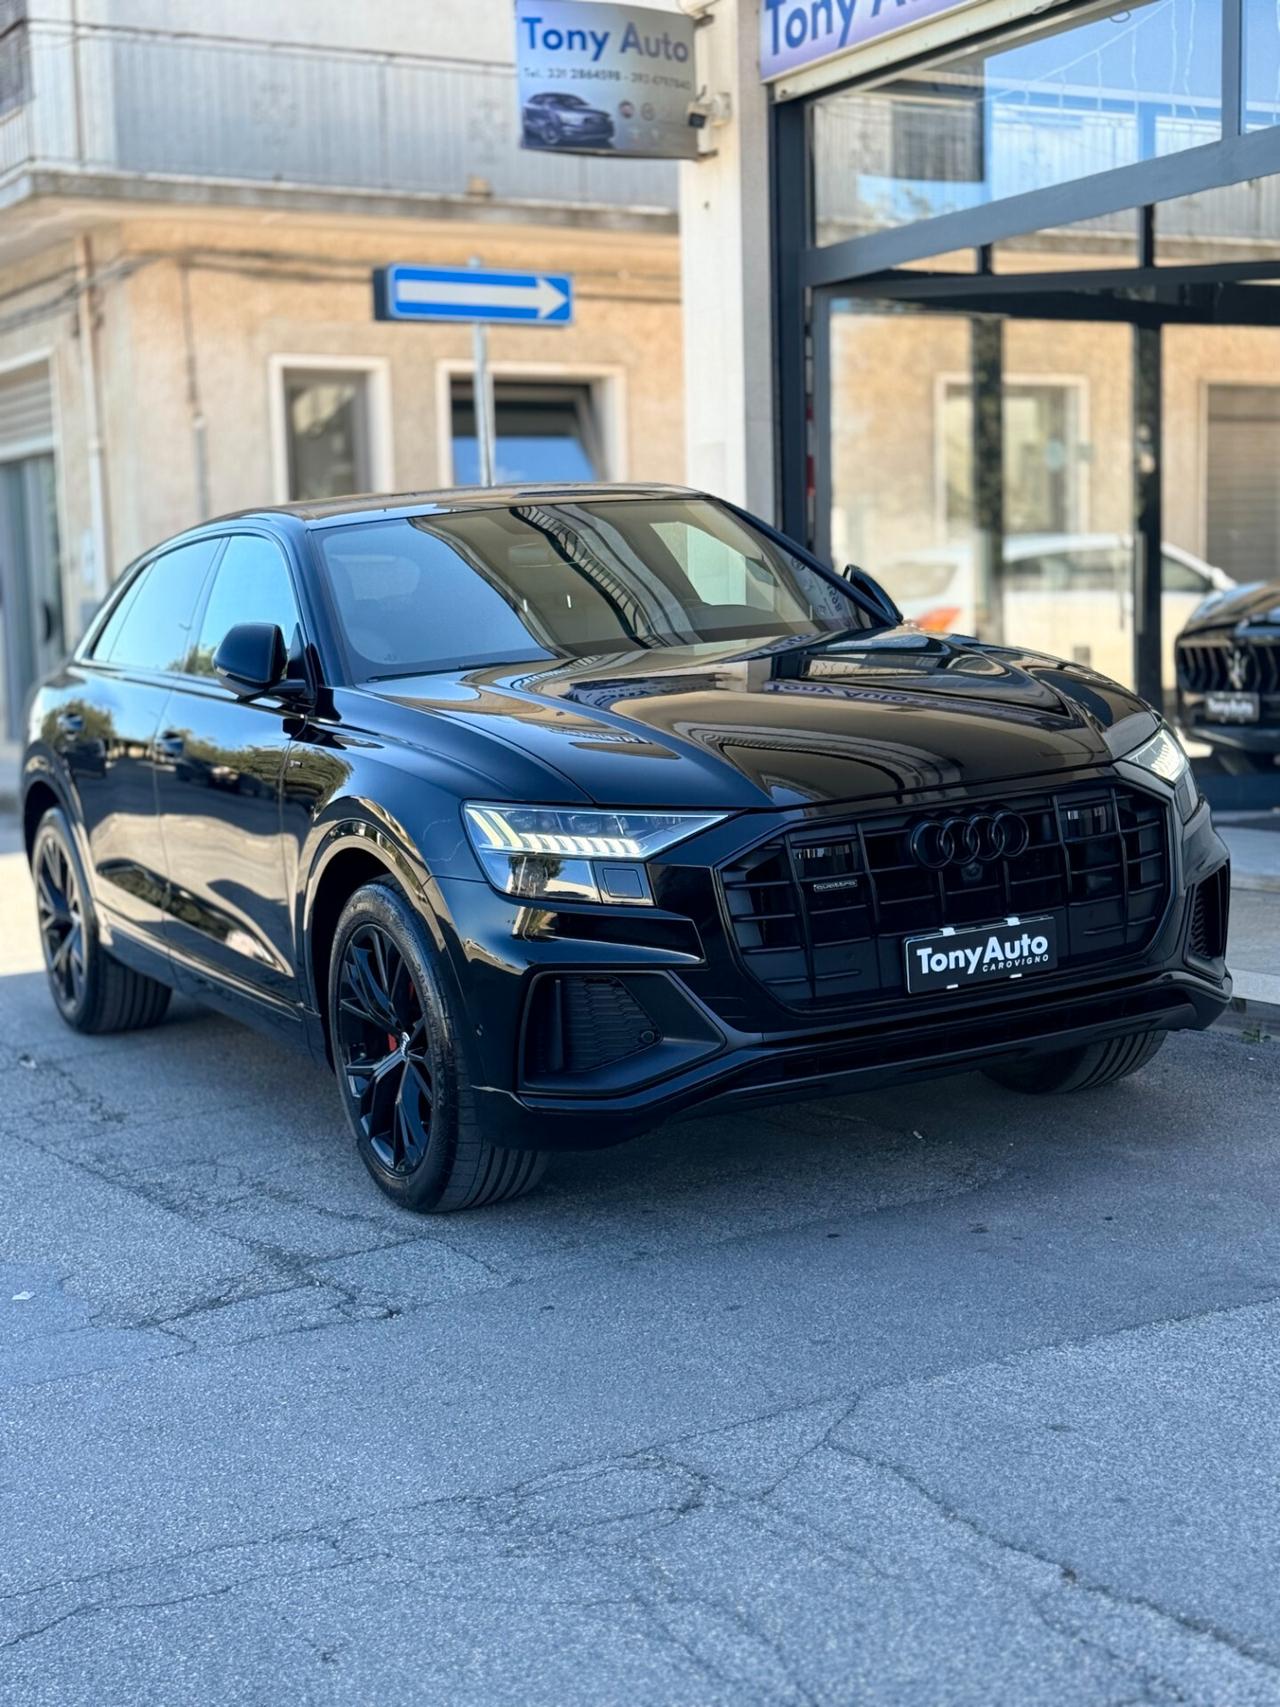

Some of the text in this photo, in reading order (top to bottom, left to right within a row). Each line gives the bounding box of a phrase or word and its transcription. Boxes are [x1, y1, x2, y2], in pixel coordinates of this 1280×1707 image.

[522, 17, 690, 63] Tony Auto
[765, 0, 858, 56] Tony
[982, 954, 1050, 972] CAROVIGNO
